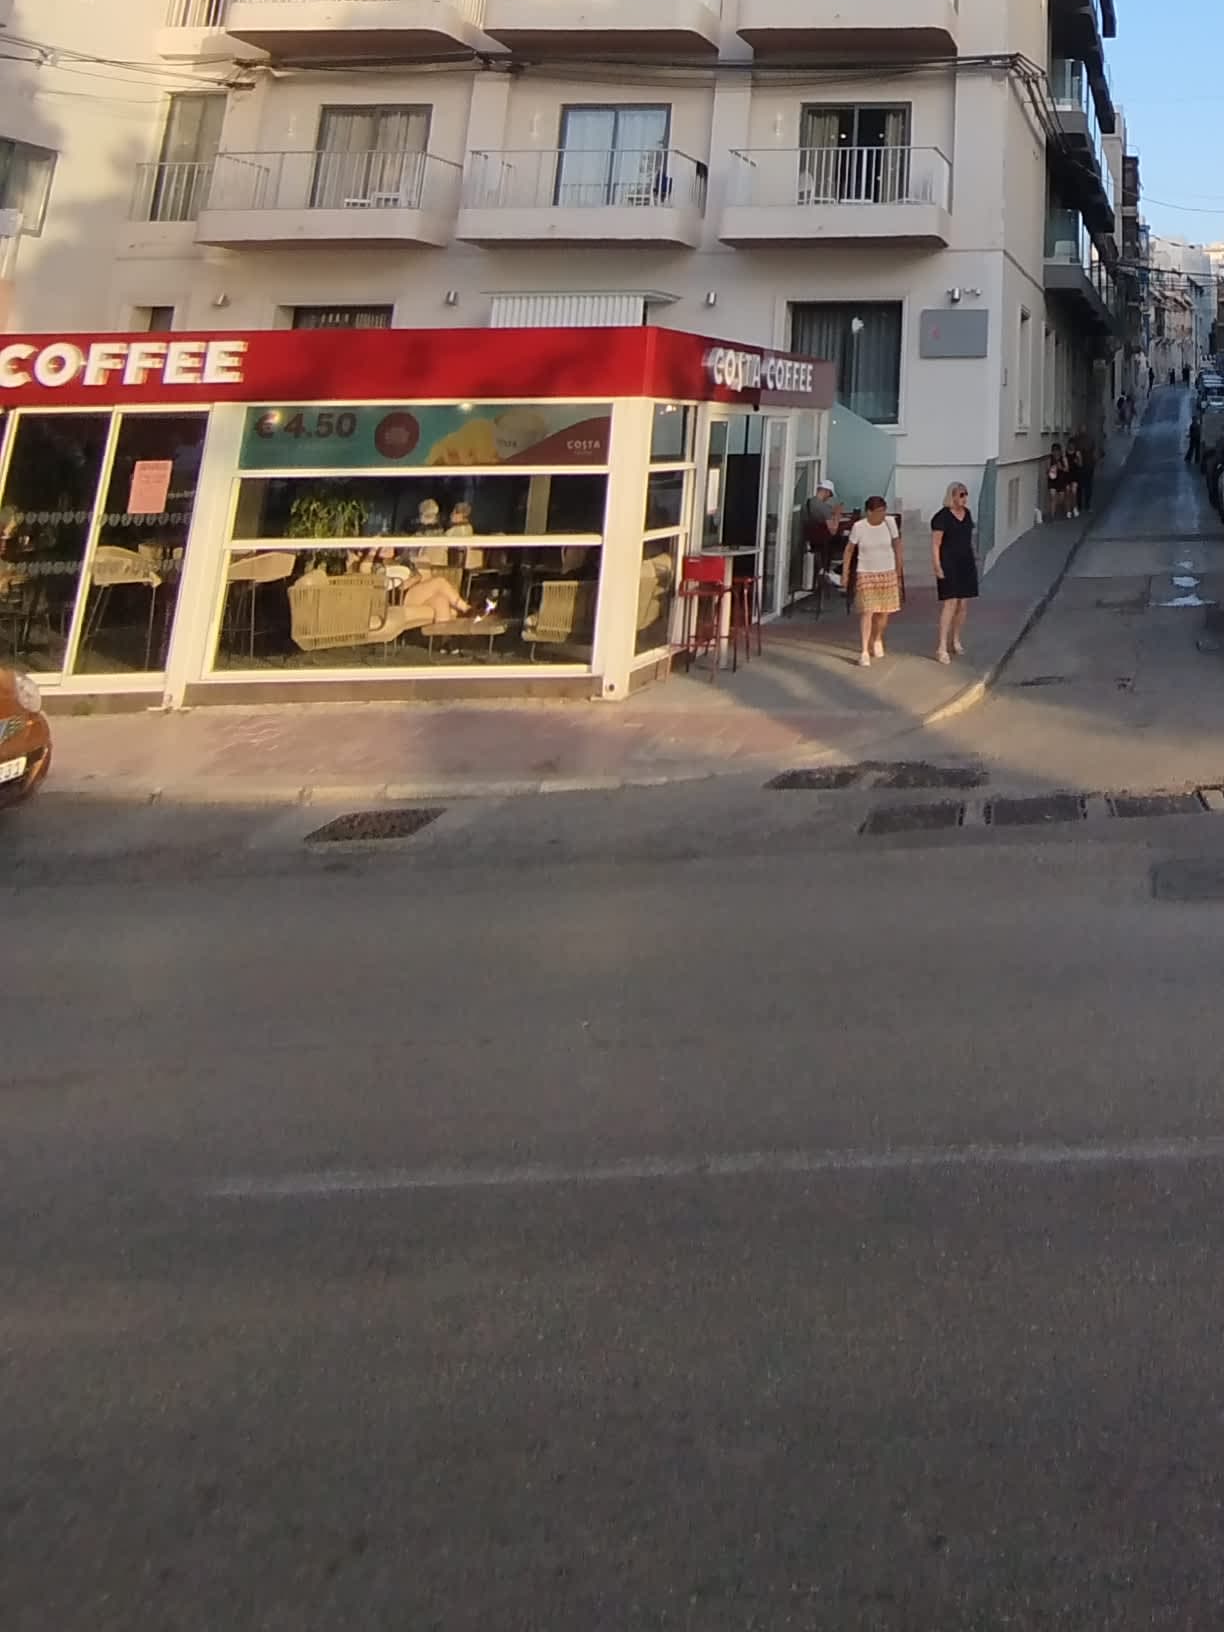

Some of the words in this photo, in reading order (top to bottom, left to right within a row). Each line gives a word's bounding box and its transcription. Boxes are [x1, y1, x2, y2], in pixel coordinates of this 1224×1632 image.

[0, 341, 249, 388] COFFEE
[711, 347, 761, 392] COSTA
[765, 357, 813, 392] COFFEE
[283, 412, 358, 439] 4.50
[566, 439, 601, 451] COSTA
